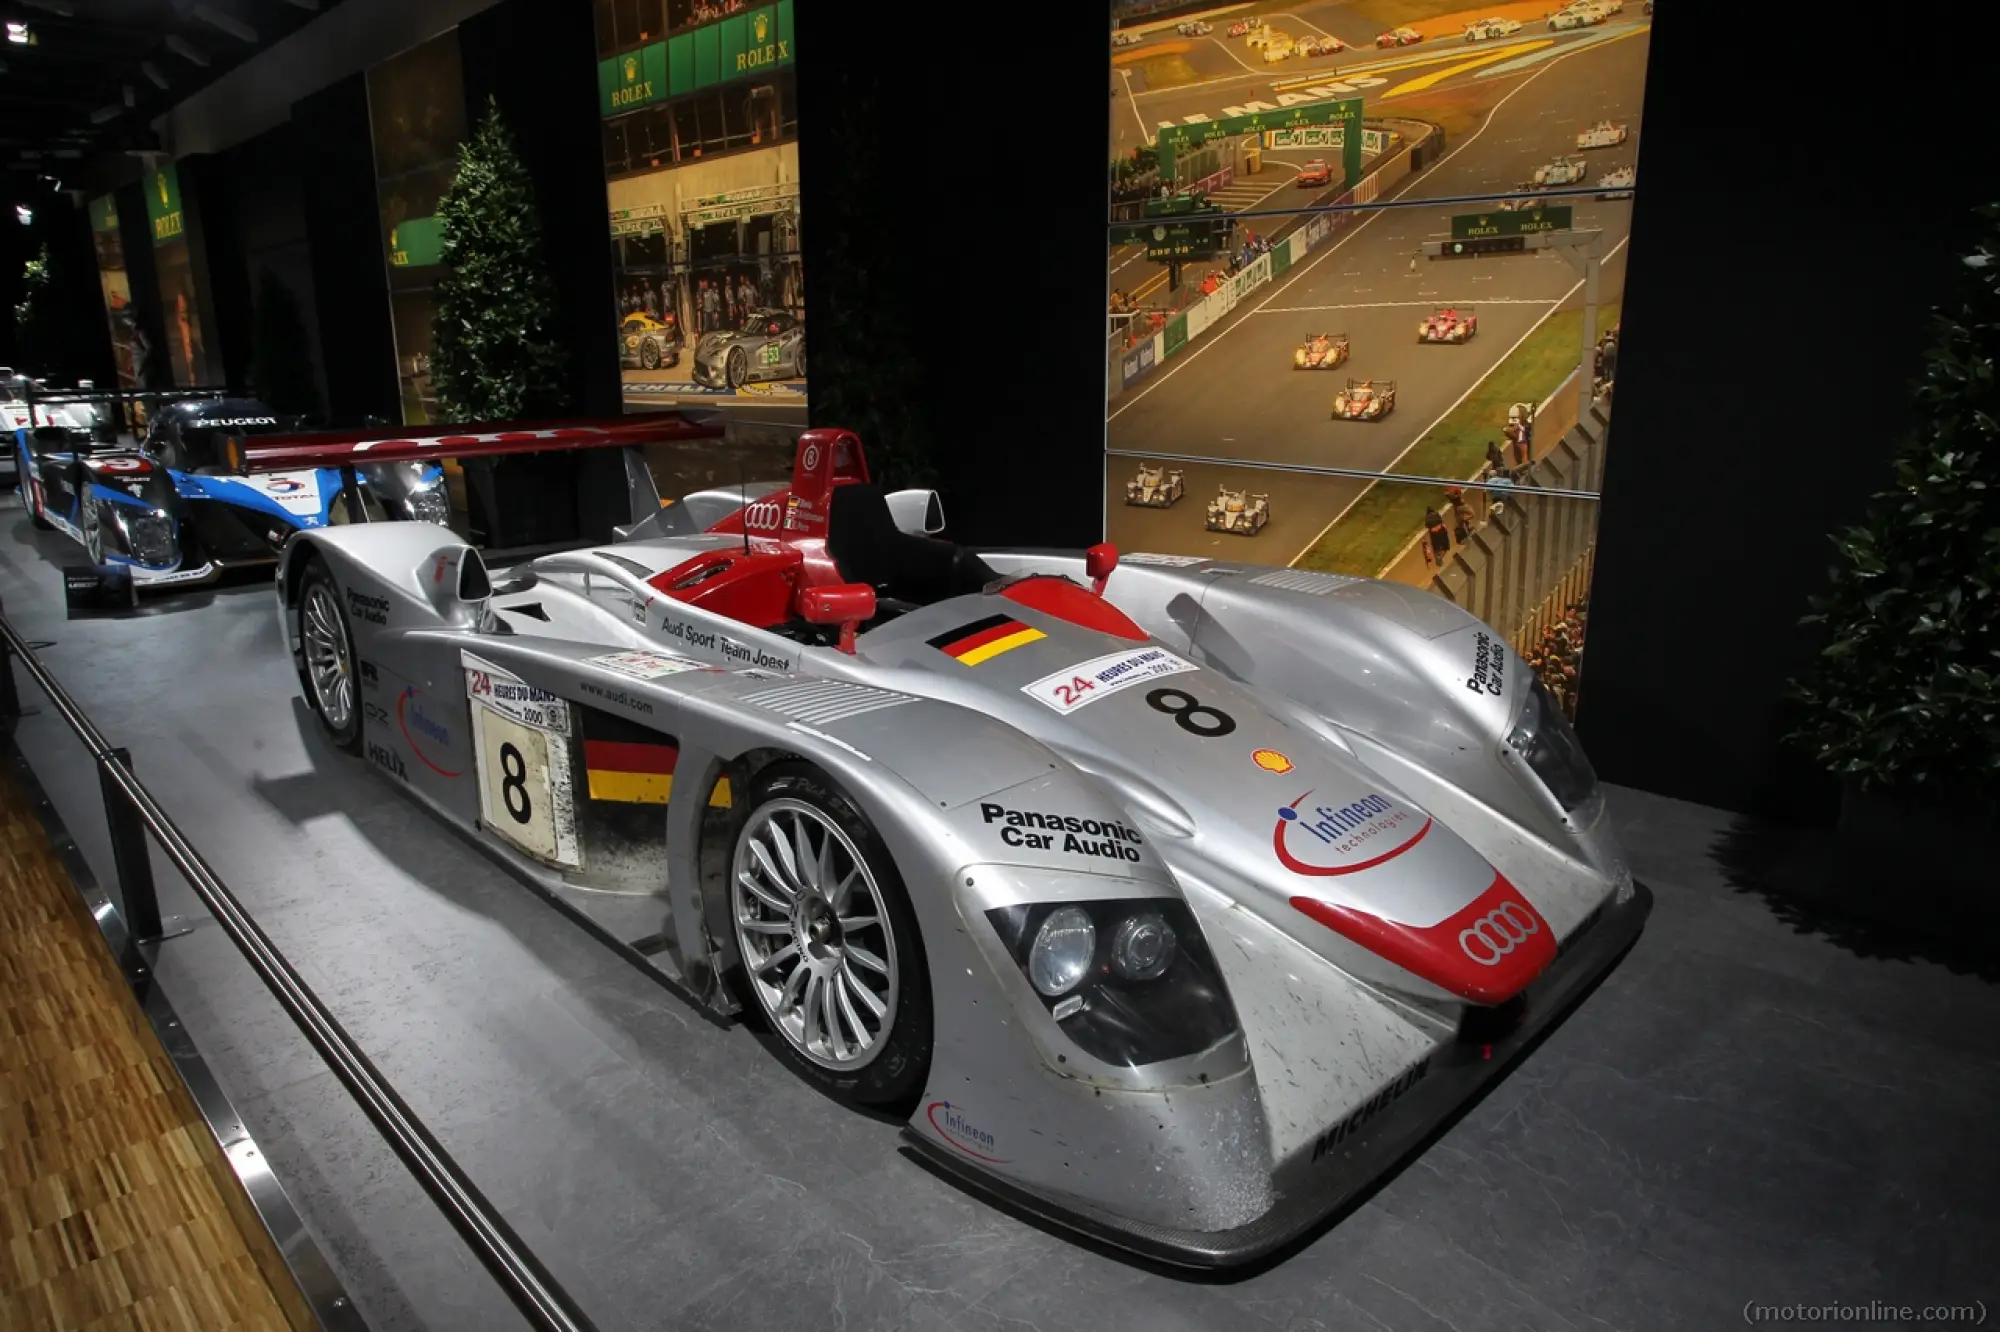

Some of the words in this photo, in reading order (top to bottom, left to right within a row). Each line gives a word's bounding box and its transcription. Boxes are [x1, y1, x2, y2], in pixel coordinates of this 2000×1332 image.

[735, 40, 789, 71] ROLEX
[611, 81, 653, 107] ROLEX
[1329, 110, 1355, 121] ROLEX
[1468, 226, 1498, 236] ROLEX
[1520, 220, 1553, 232] ROLEX
[196, 416, 277, 428] PEUGEOT
[661, 617, 684, 639] Audi
[685, 624, 716, 650] Sport
[718, 636, 751, 663] Team
[752, 649, 790, 671] Joest
[1053, 676, 1096, 706] 24
[1095, 661, 1130, 684] HEURES
[1138, 650, 1166, 663] MANS
[1466, 631, 1490, 696] Panasonic
[472, 670, 492, 696] 24
[493, 683, 517, 701] HEURES
[517, 685, 529, 702] DU
[529, 687, 556, 702] MANS
[579, 681, 654, 716] www.audi.com
[1487, 674, 1503, 697] Car
[364, 702, 390, 726] OZ
[523, 707, 544, 725] 2000
[1144, 687, 1237, 738] 8
[499, 741, 532, 824] 8
[980, 802, 1143, 845] Panasonic
[1299, 793, 1393, 844] Infineon
[1335, 810, 1409, 855] technologies
[1000, 826, 1054, 850] Car
[1063, 833, 1140, 863] Audio
[1311, 1056, 1431, 1164] MICHELIN
[945, 1111, 995, 1147] Infineon
